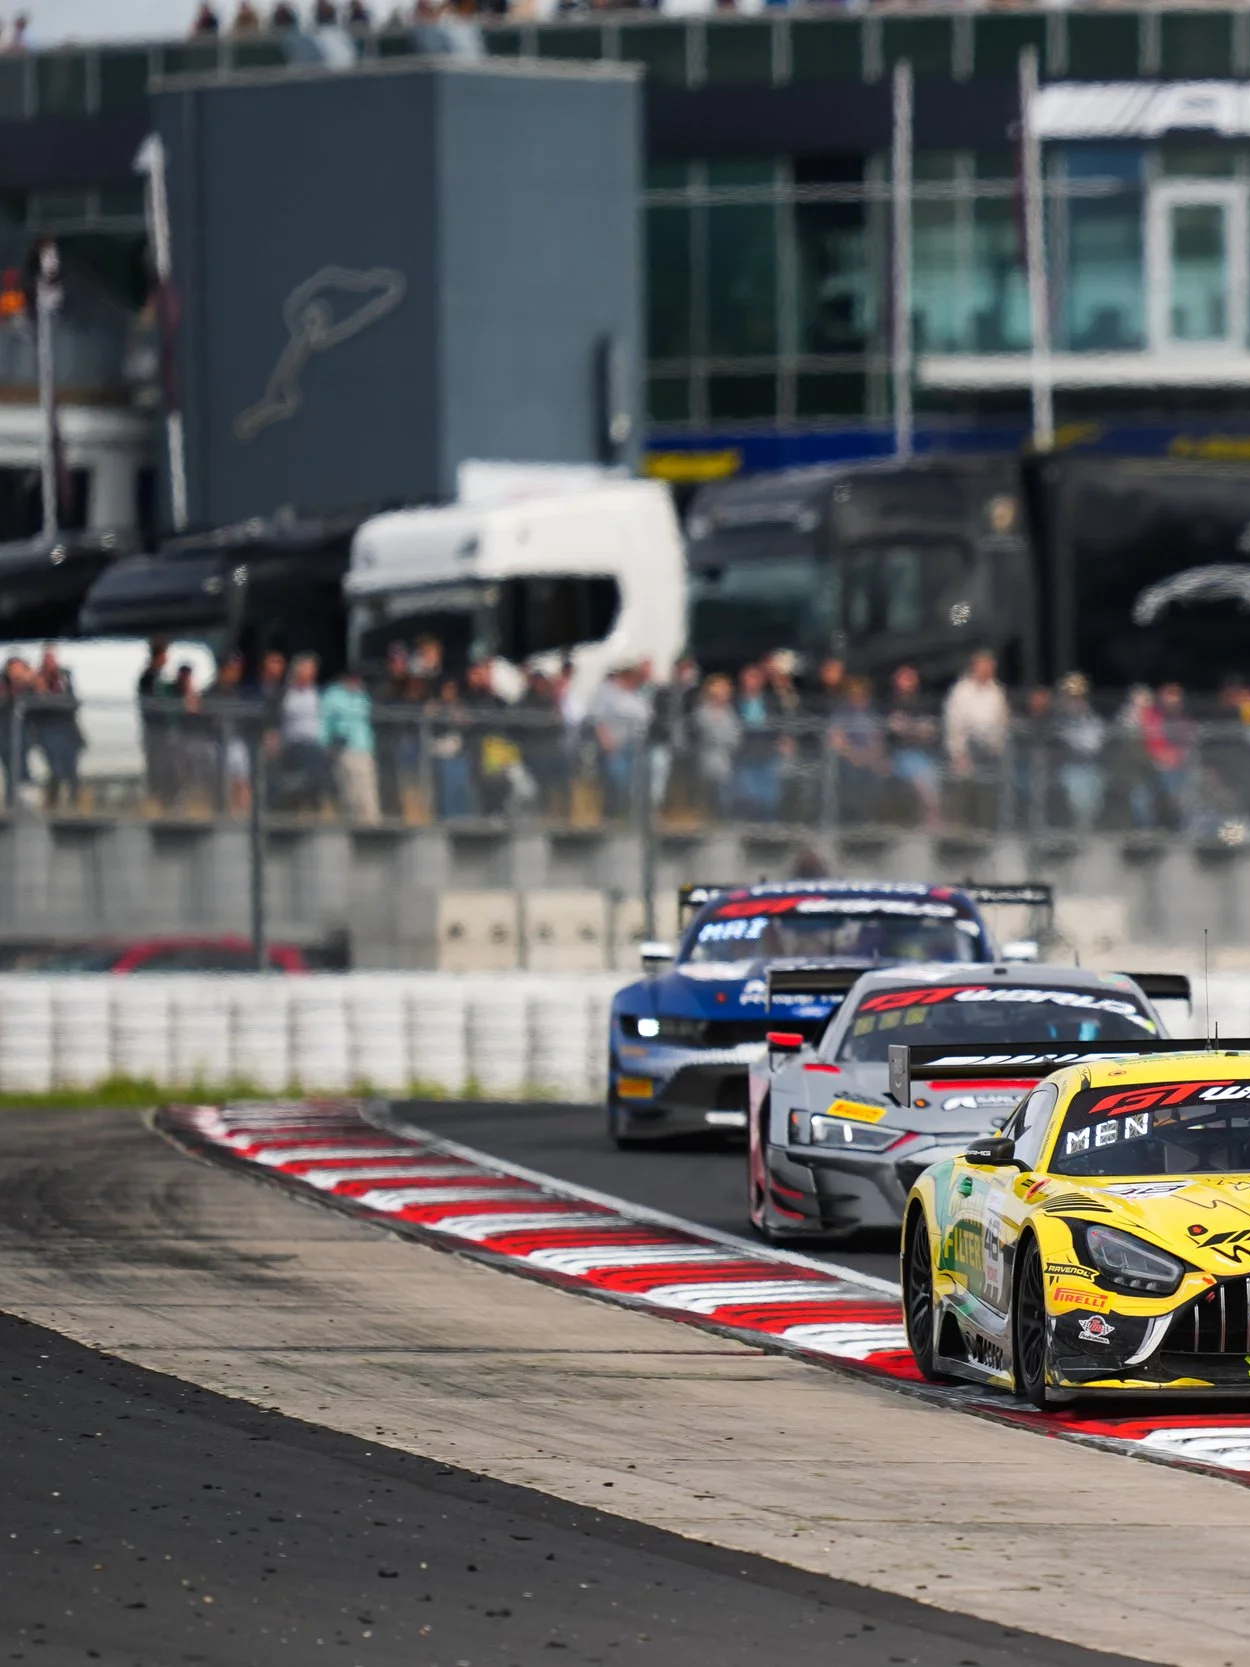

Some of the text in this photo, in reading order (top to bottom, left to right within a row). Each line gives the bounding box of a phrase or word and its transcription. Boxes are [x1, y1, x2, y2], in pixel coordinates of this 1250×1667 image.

[860, 985, 988, 1012] GT
[1089, 1081, 1235, 1117] GT
[1066, 1112, 1149, 1155] MEN
[944, 1227, 983, 1270] FILTER
[1048, 1265, 1091, 1278] RAVENOL
[1053, 1287, 1109, 1308] PIRELLI
